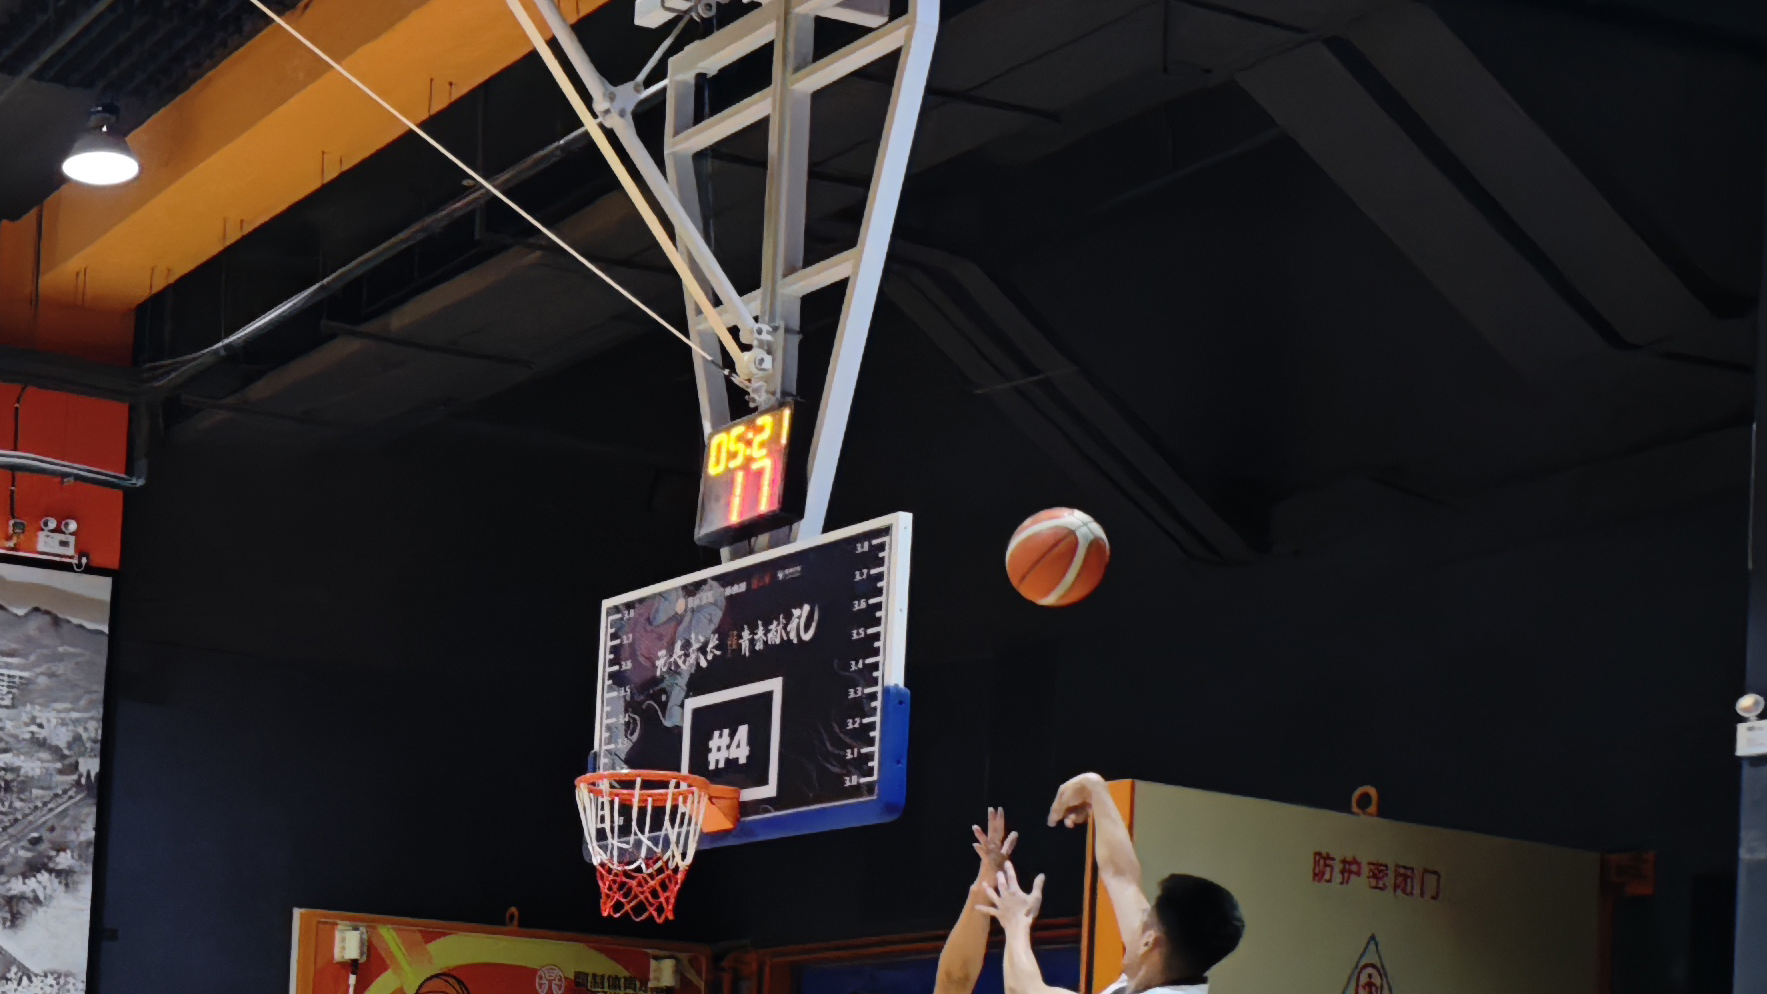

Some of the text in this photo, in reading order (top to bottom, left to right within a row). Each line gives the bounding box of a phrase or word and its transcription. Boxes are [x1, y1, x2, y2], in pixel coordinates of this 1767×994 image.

[708, 407, 791, 476] 05:21
[731, 458, 771, 523] 17
[707, 723, 750, 770] #4
[1312, 851, 1441, 901] 防护密闭门
